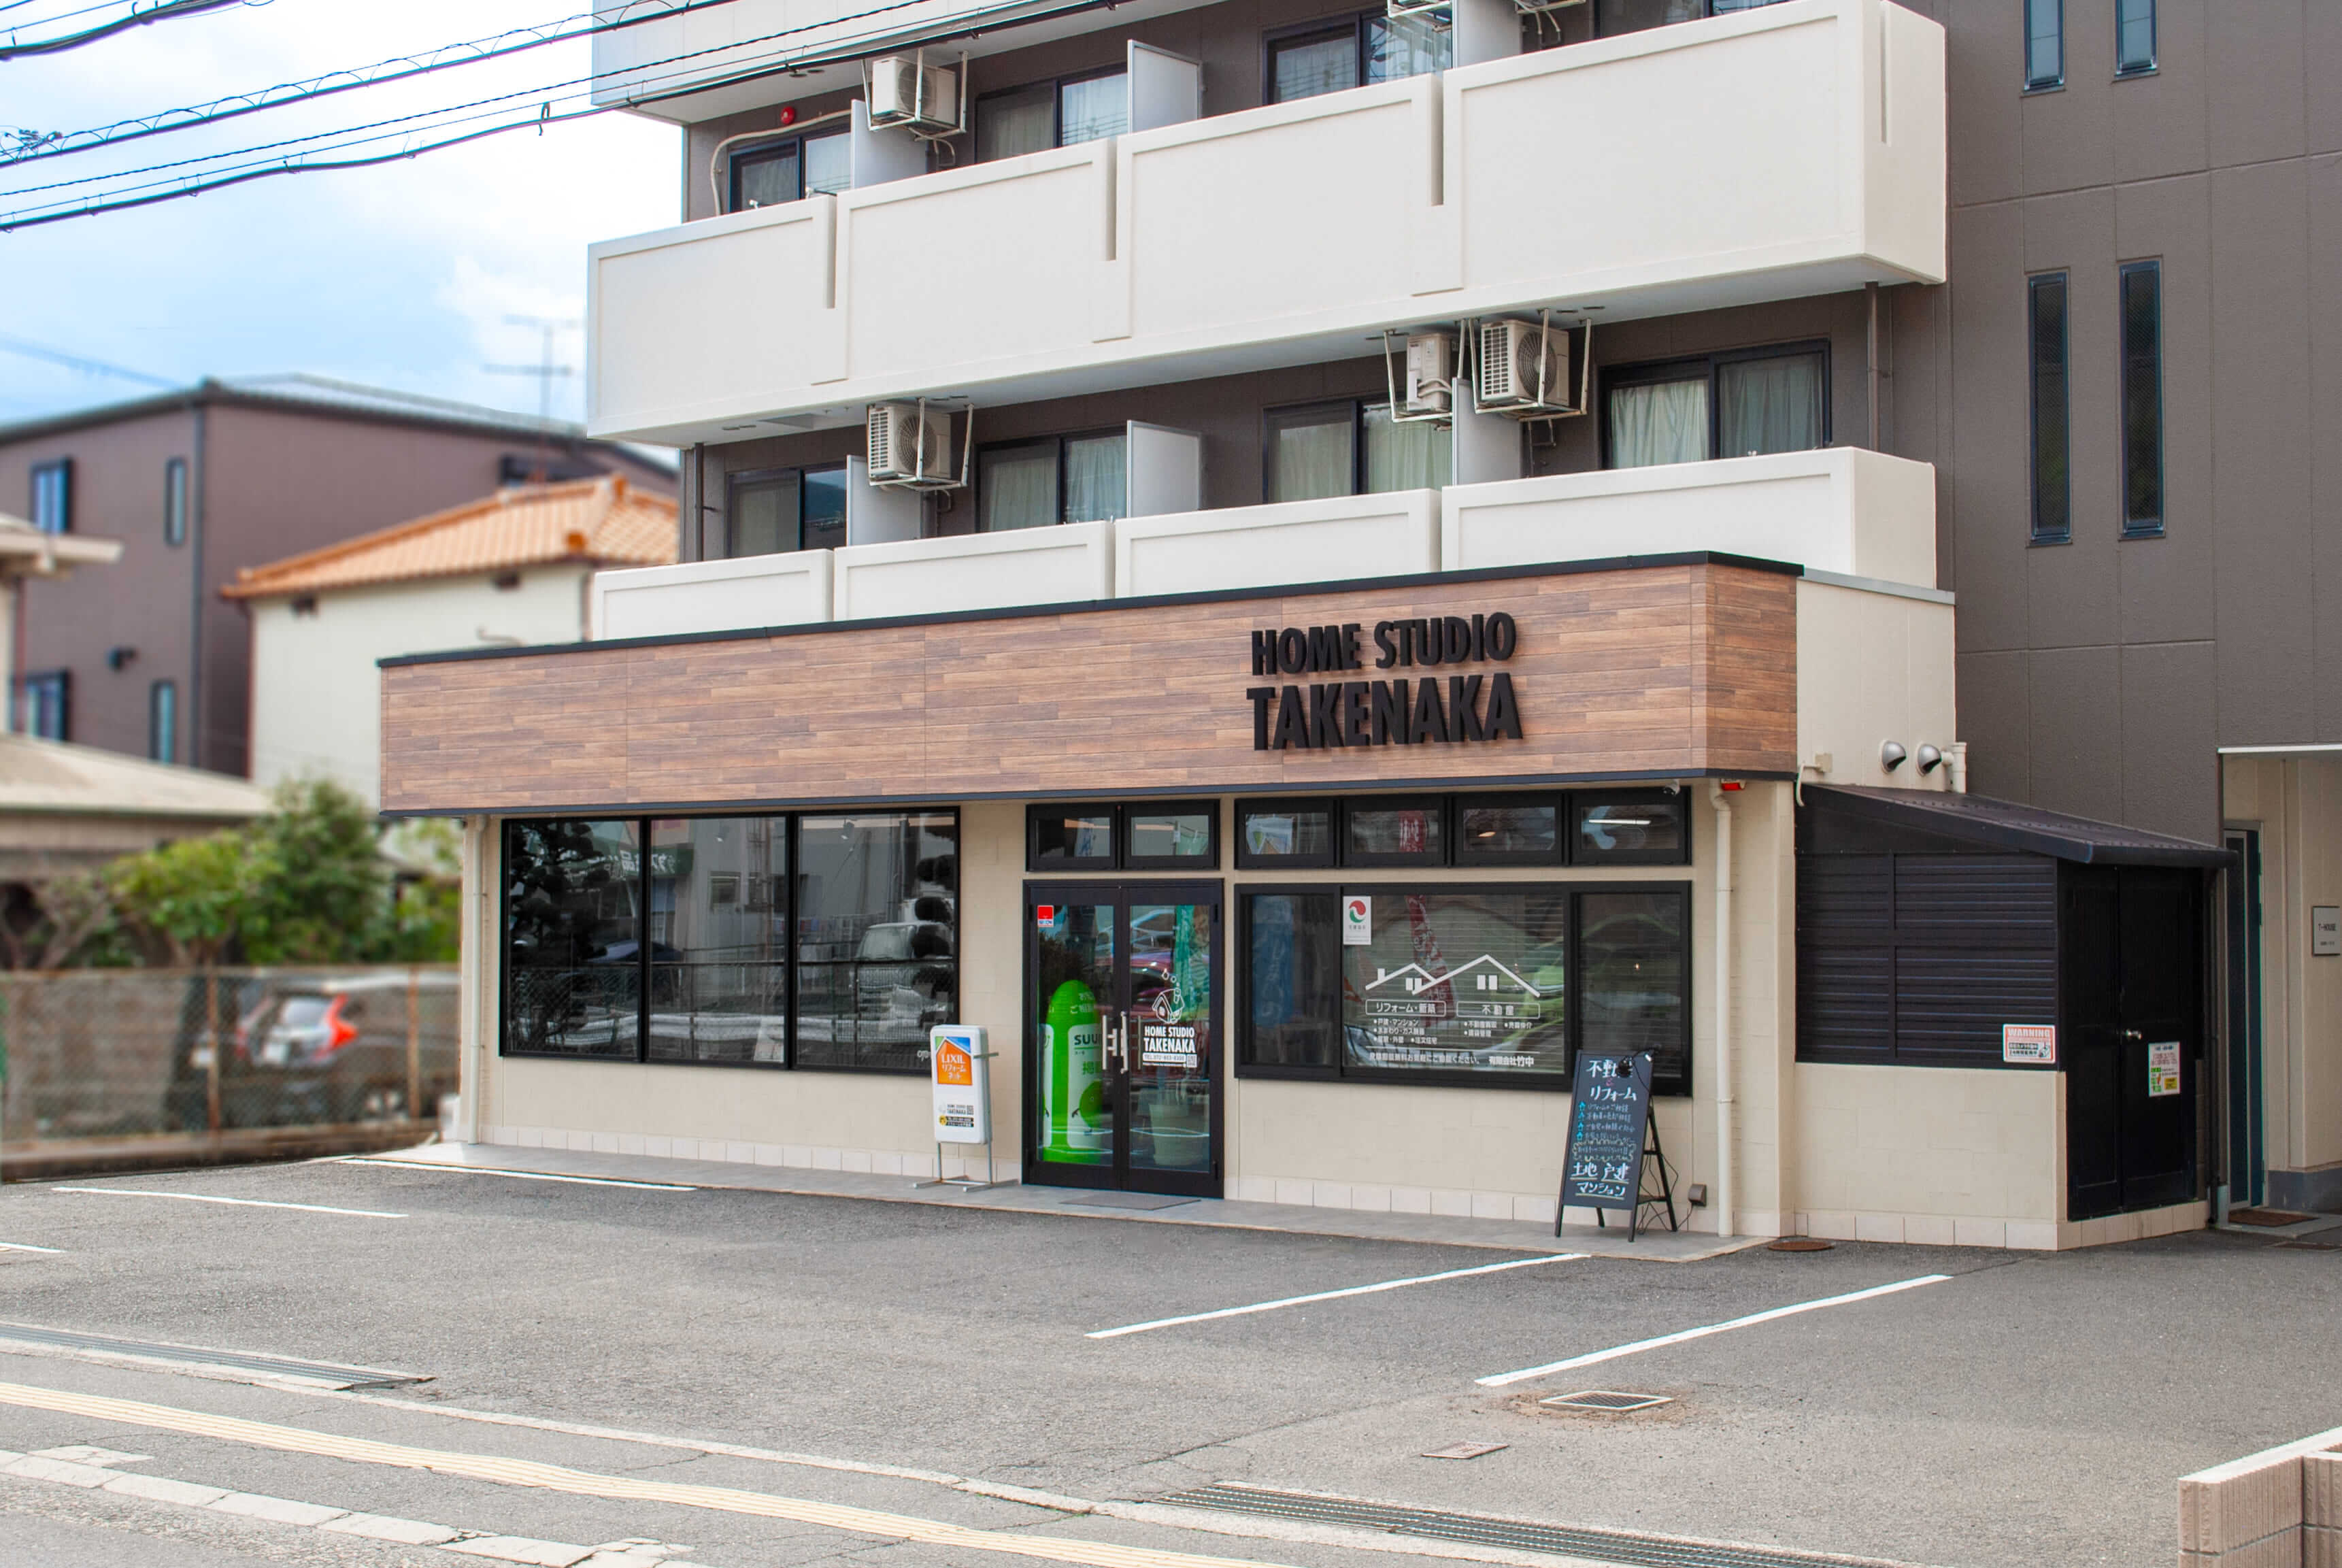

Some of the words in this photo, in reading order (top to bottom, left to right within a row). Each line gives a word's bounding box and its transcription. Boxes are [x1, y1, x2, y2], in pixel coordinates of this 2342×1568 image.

[1252, 623, 1361, 675] HOME
[1374, 612, 1516, 669] STUDIO
[1246, 672, 1523, 751] TAKENAKA
[1145, 1026, 1167, 1037] HOME
[1169, 1027, 1195, 1038] STUDIO
[1143, 1037, 1196, 1053] TAKENAKA
[941, 1054, 965, 1064] LIXIL
[1590, 1085, 1637, 1101] リフォーム
[1571, 1162, 1599, 1177] 土地
[1601, 1162, 1630, 1182] 戸建
[1577, 1181, 1626, 1196] マンション
